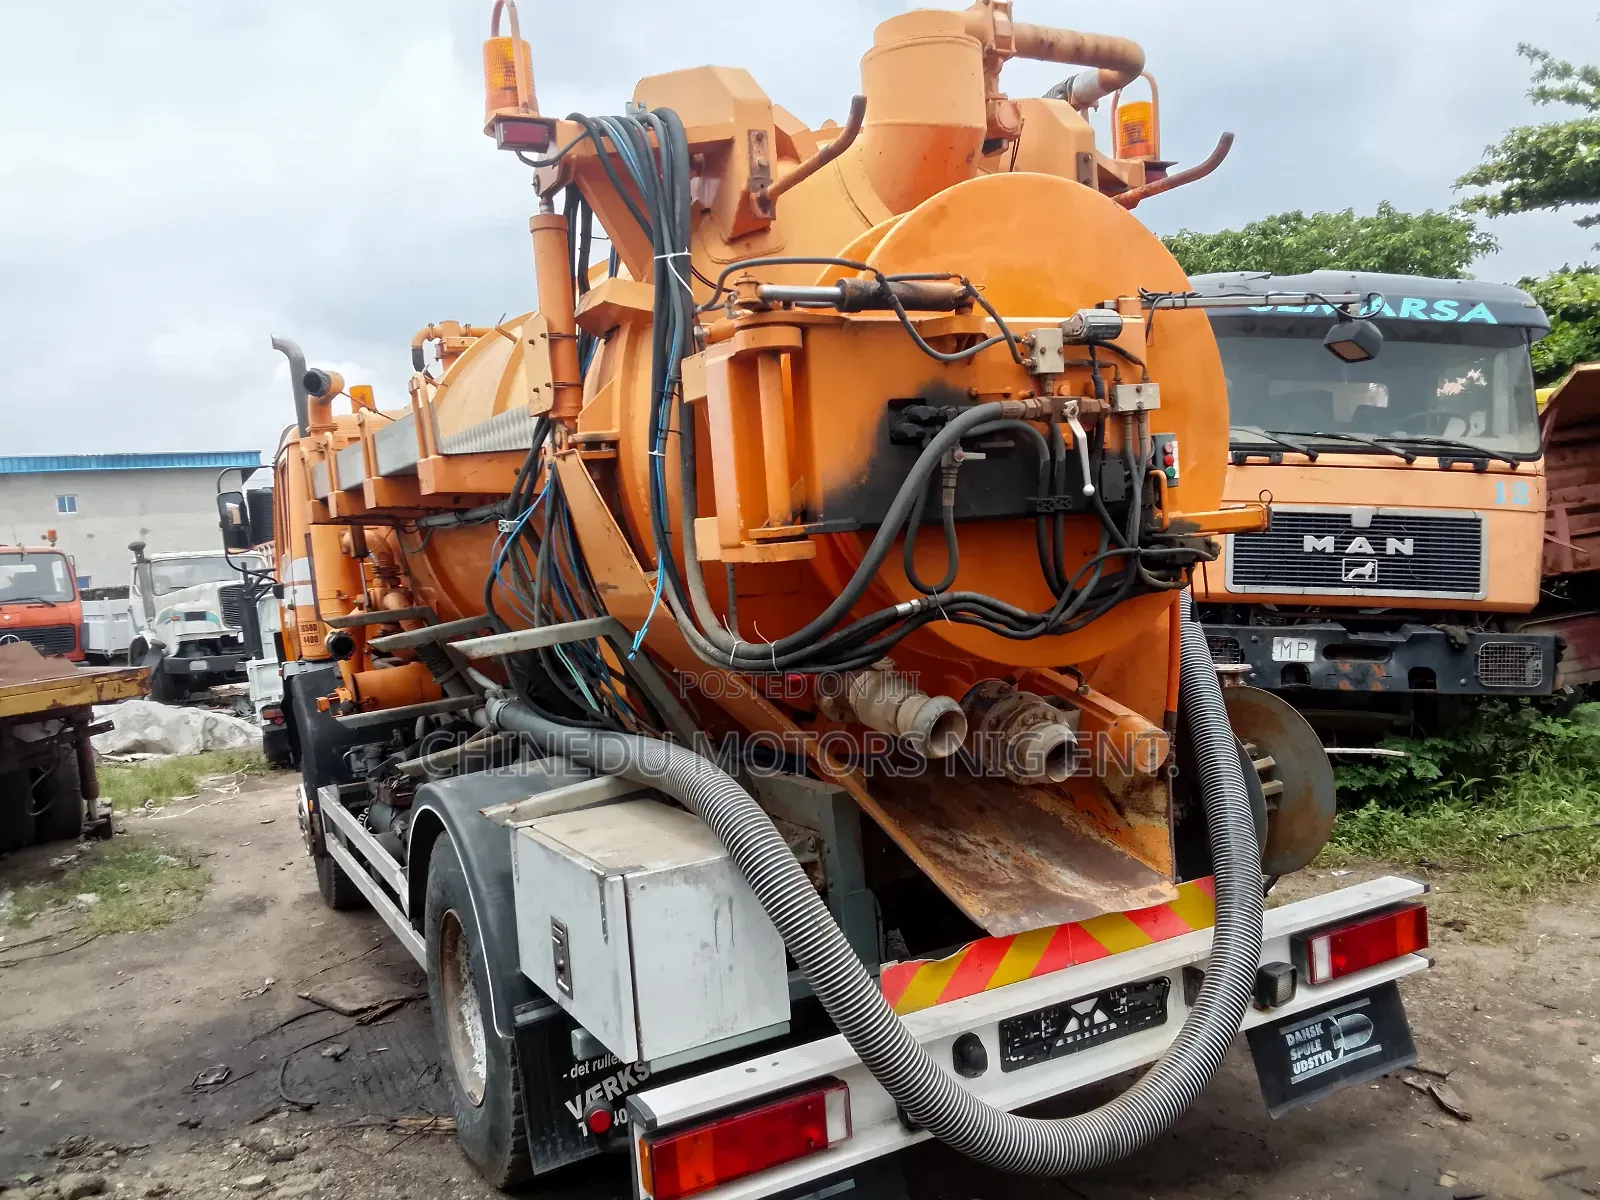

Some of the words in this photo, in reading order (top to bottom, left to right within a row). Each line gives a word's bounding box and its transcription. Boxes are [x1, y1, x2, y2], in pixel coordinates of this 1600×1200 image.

[1494, 481, 1529, 505] 12
[1303, 535, 1414, 556] MAN
[1279, 641, 1309, 659] MP
[1285, 1022, 1324, 1047] DANSK
[1289, 1038, 1322, 1061] SPULE
[570, 1060, 590, 1079] det
[592, 1053, 621, 1072] rulle
[1292, 1050, 1333, 1075] UDSTYR
